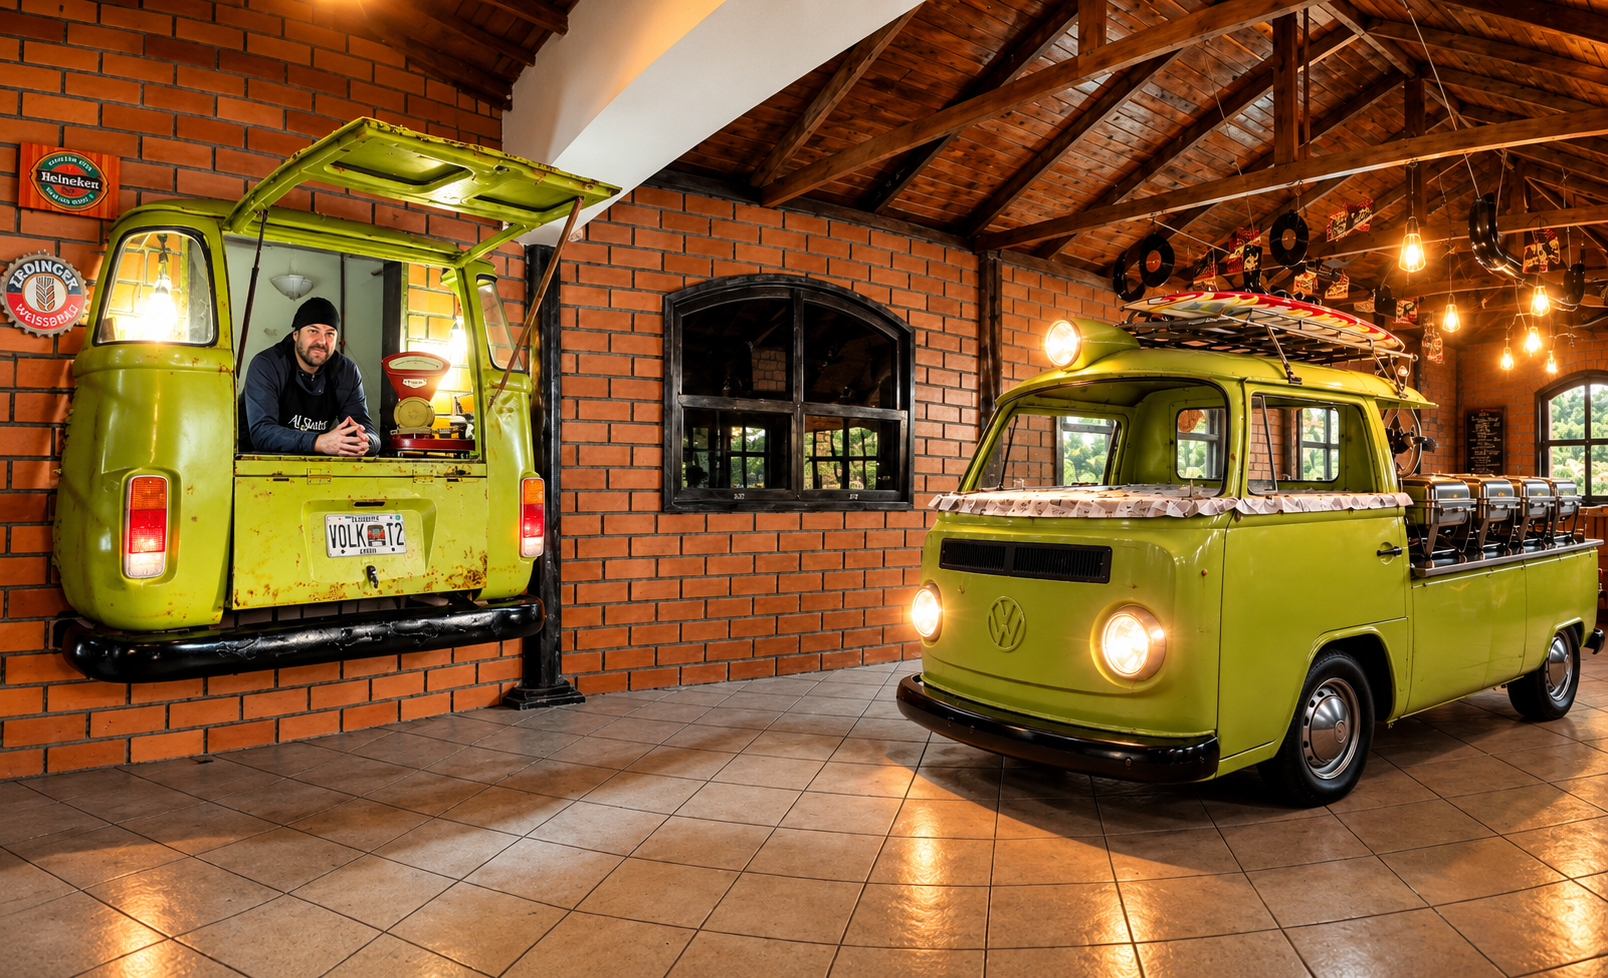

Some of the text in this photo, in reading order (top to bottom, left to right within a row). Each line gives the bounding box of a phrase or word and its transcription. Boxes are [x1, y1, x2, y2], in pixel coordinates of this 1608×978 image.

[41, 171, 100, 190] Heineken
[328, 522, 405, 549] VOLK T2
